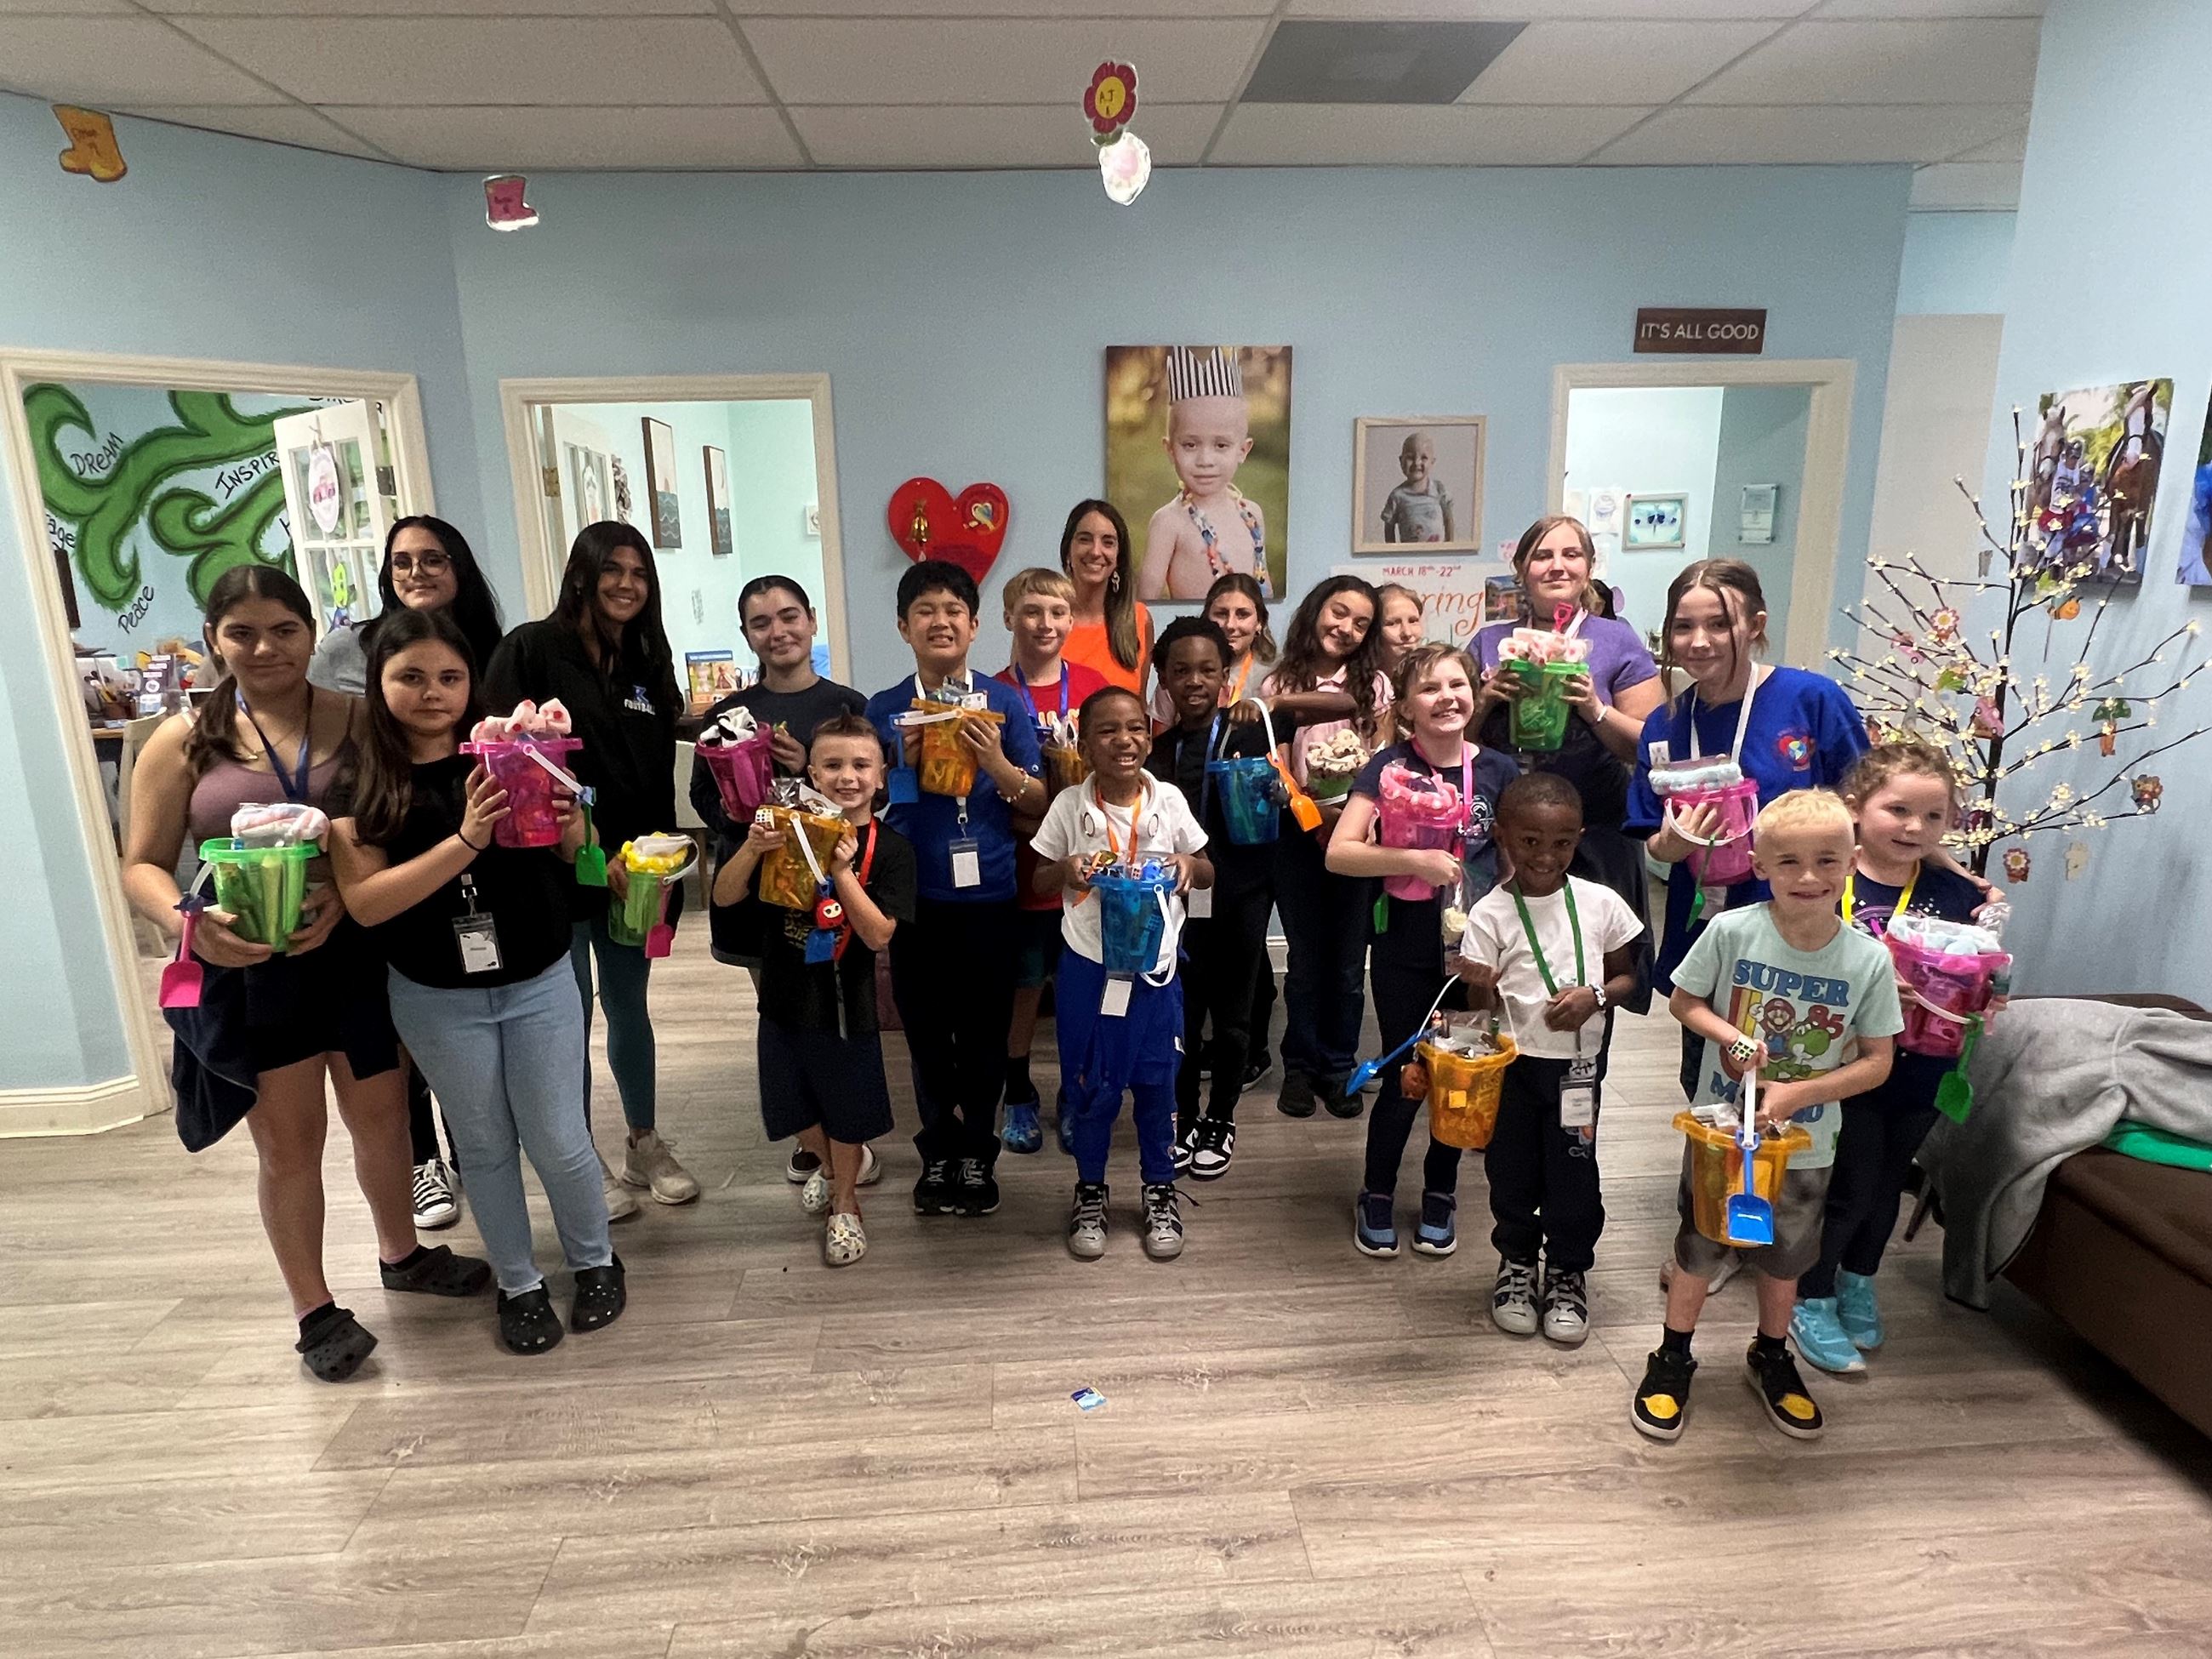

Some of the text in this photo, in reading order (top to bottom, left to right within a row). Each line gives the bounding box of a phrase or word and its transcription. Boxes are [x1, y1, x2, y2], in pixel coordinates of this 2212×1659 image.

[1641, 322, 1759, 339] IT'S ALL GOOD
[1382, 566, 1413, 576] MARCH
[117, 585, 154, 635] Peace
[624, 698, 656, 715] FOOTBALL
[1732, 959, 1850, 1007] SUPER
[1808, 1005, 1845, 1040] 85
